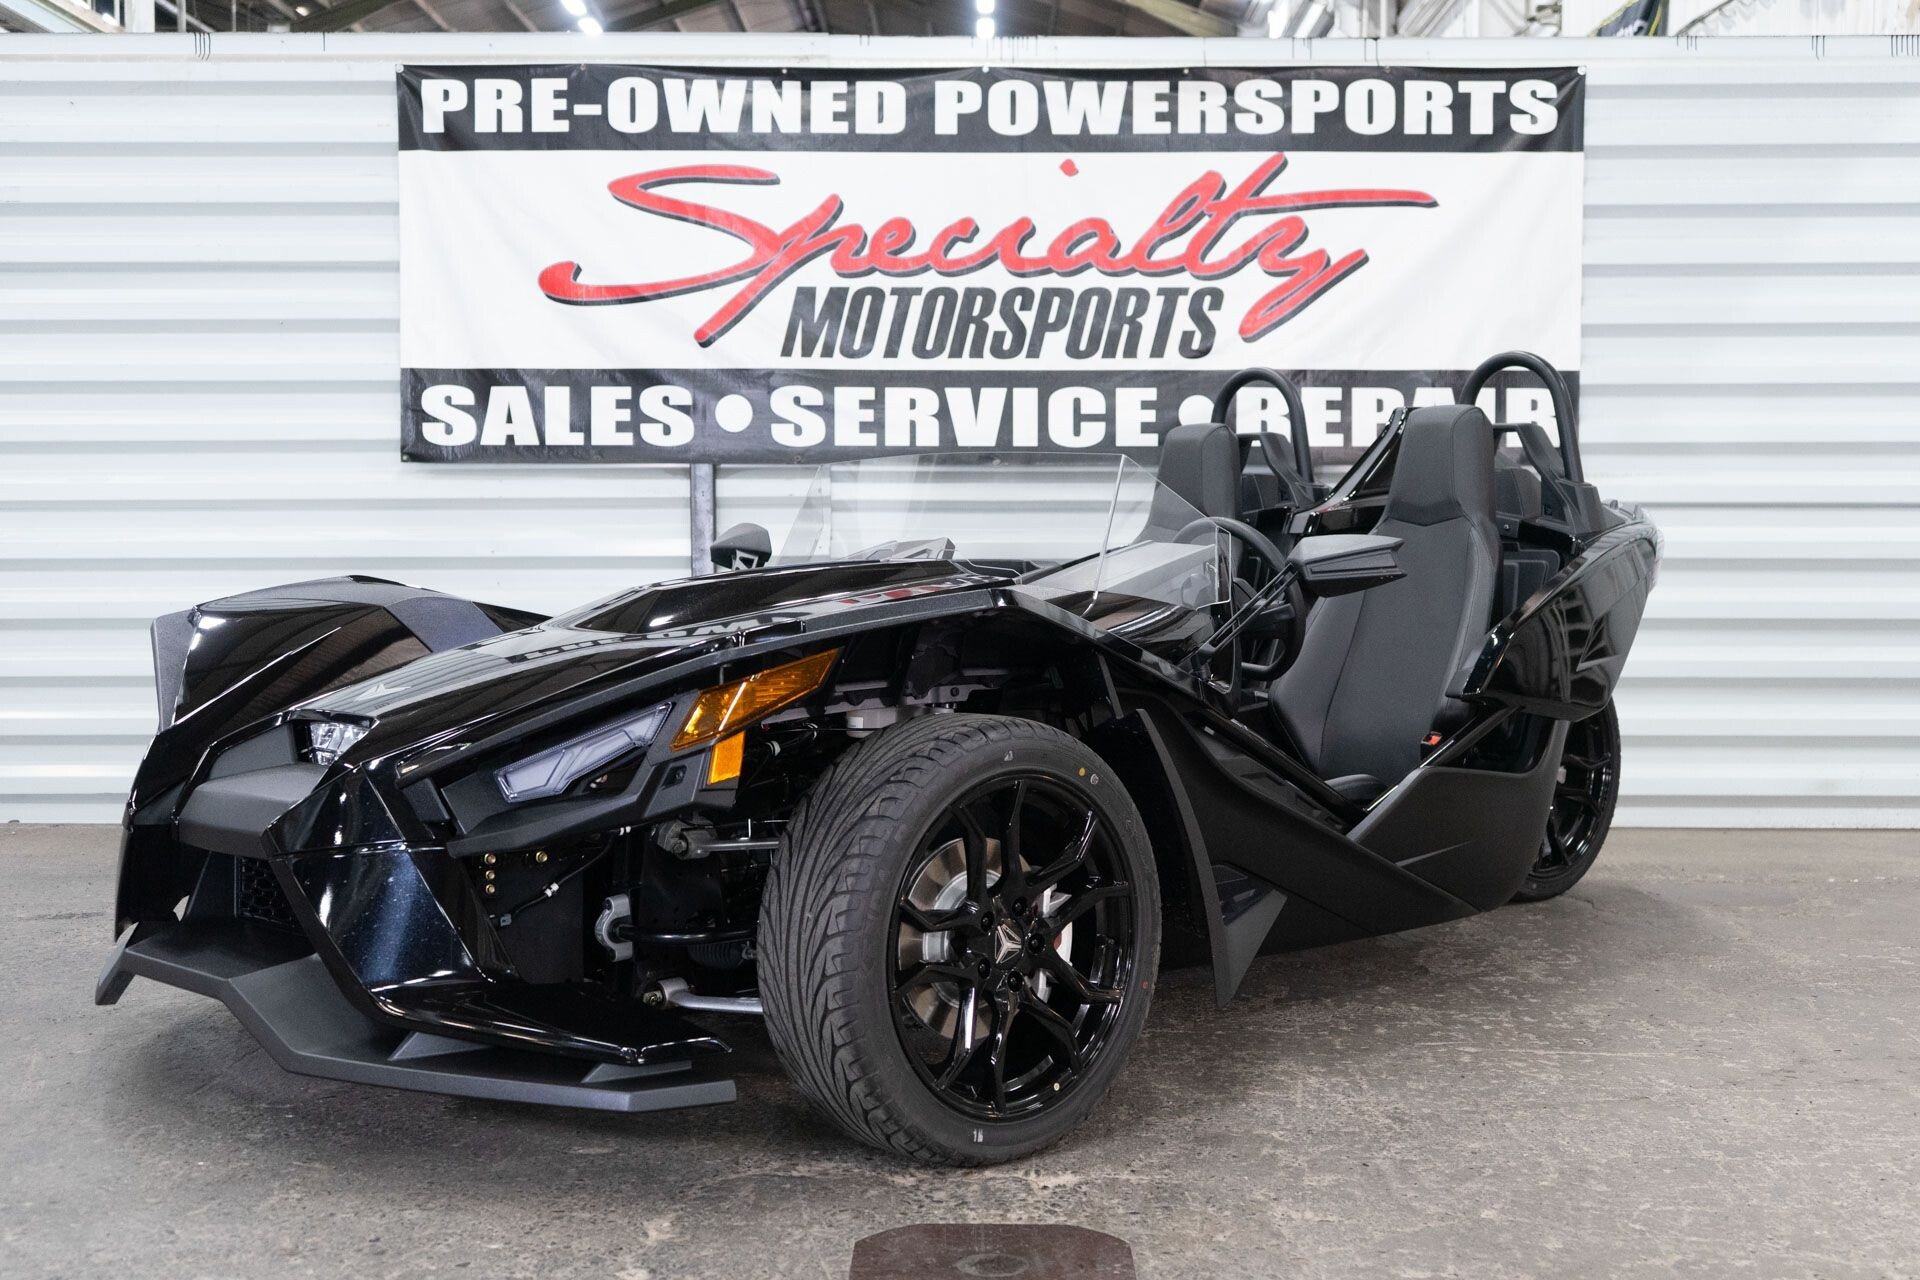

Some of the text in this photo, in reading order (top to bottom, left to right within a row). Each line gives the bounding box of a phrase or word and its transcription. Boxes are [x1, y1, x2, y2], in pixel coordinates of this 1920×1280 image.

[420, 76, 1559, 136] PRE-OWNED POWERSPORTS
[538, 152, 1439, 349] Specialty
[780, 286, 1224, 360] MOTORSPORTS
[421, 384, 1561, 448] SALES SERVICE REPR
